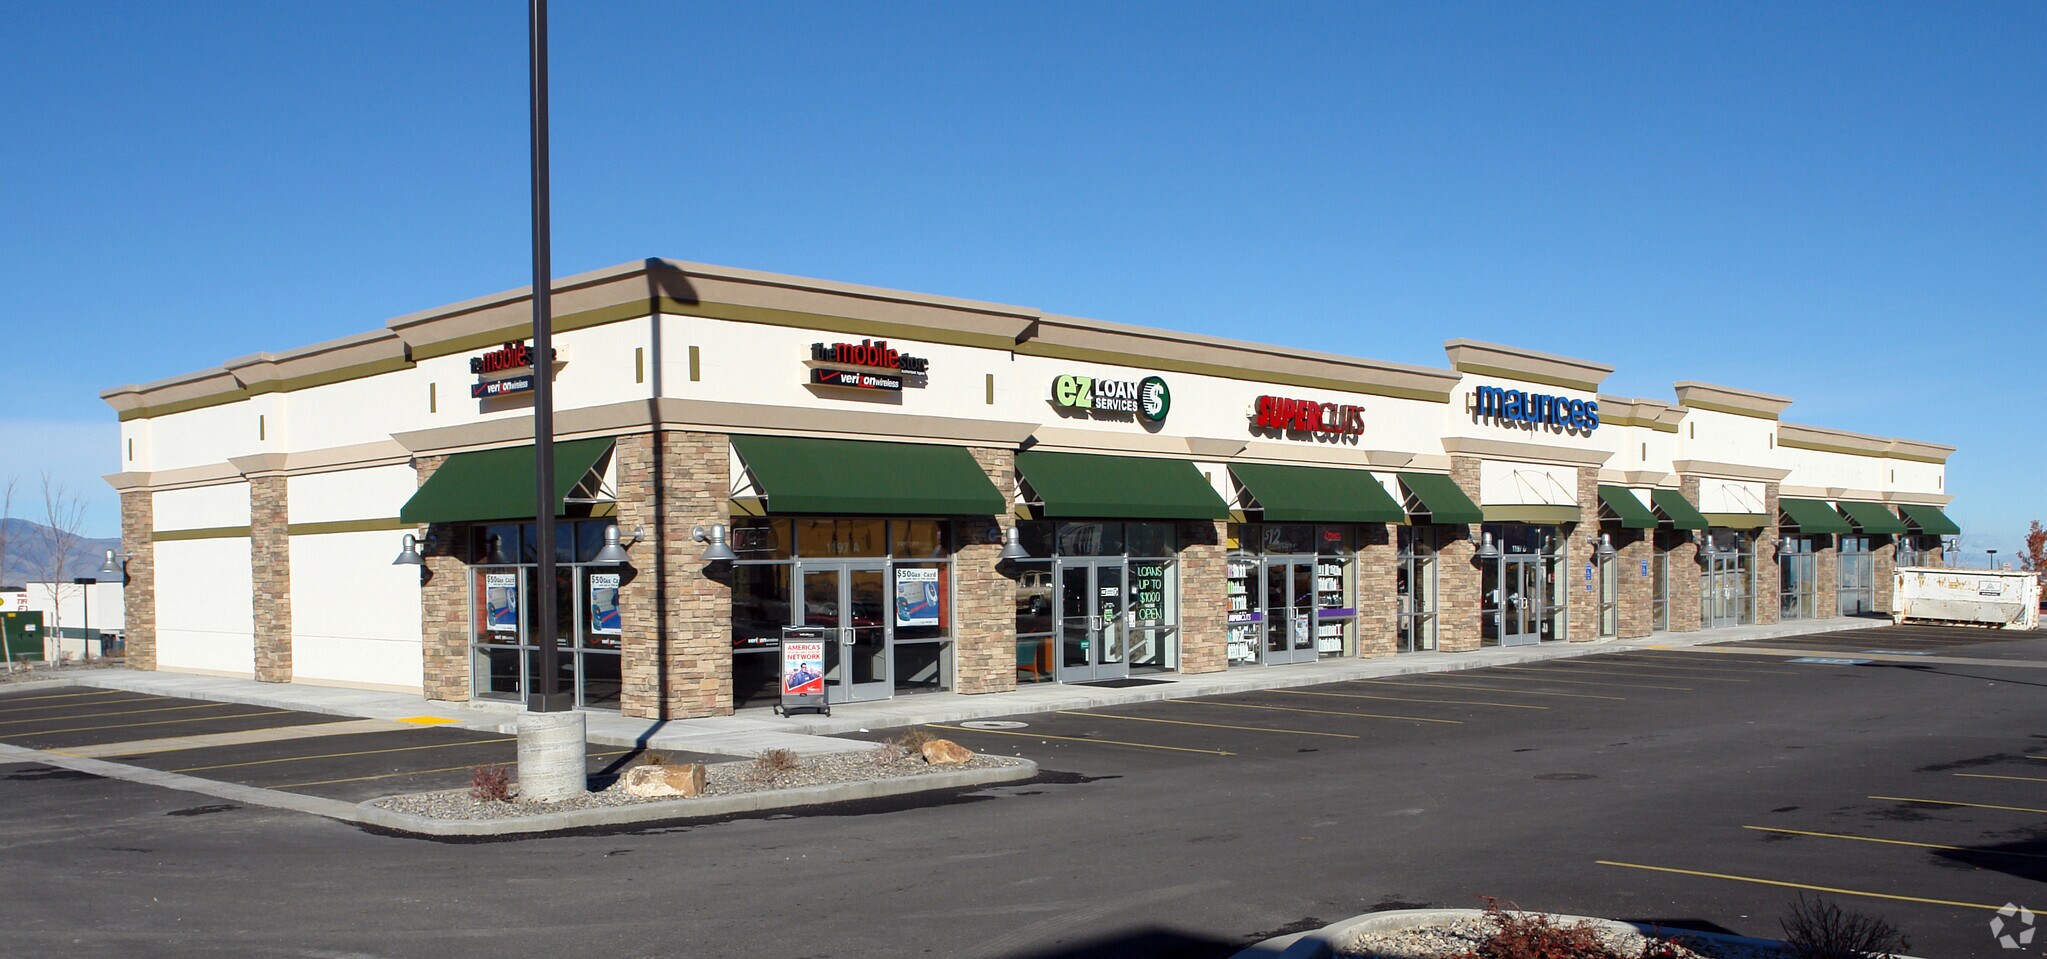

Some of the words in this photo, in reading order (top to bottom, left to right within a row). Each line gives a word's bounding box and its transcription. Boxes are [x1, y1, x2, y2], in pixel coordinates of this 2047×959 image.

[482, 340, 526, 373] mobile
[835, 339, 899, 368] mobile
[1095, 378, 1138, 399] LOAN
[1095, 399, 1138, 412] SERVICES
[1476, 386, 1599, 430] maurices
[1257, 395, 1365, 436] SUPERCUTS
[1137, 566, 1162, 576] LOANS
[1138, 579, 1149, 590] UP
[1150, 579, 1161, 590] TO
[1140, 592, 1160, 604] $1000
[1139, 608, 1162, 620] OPEN
